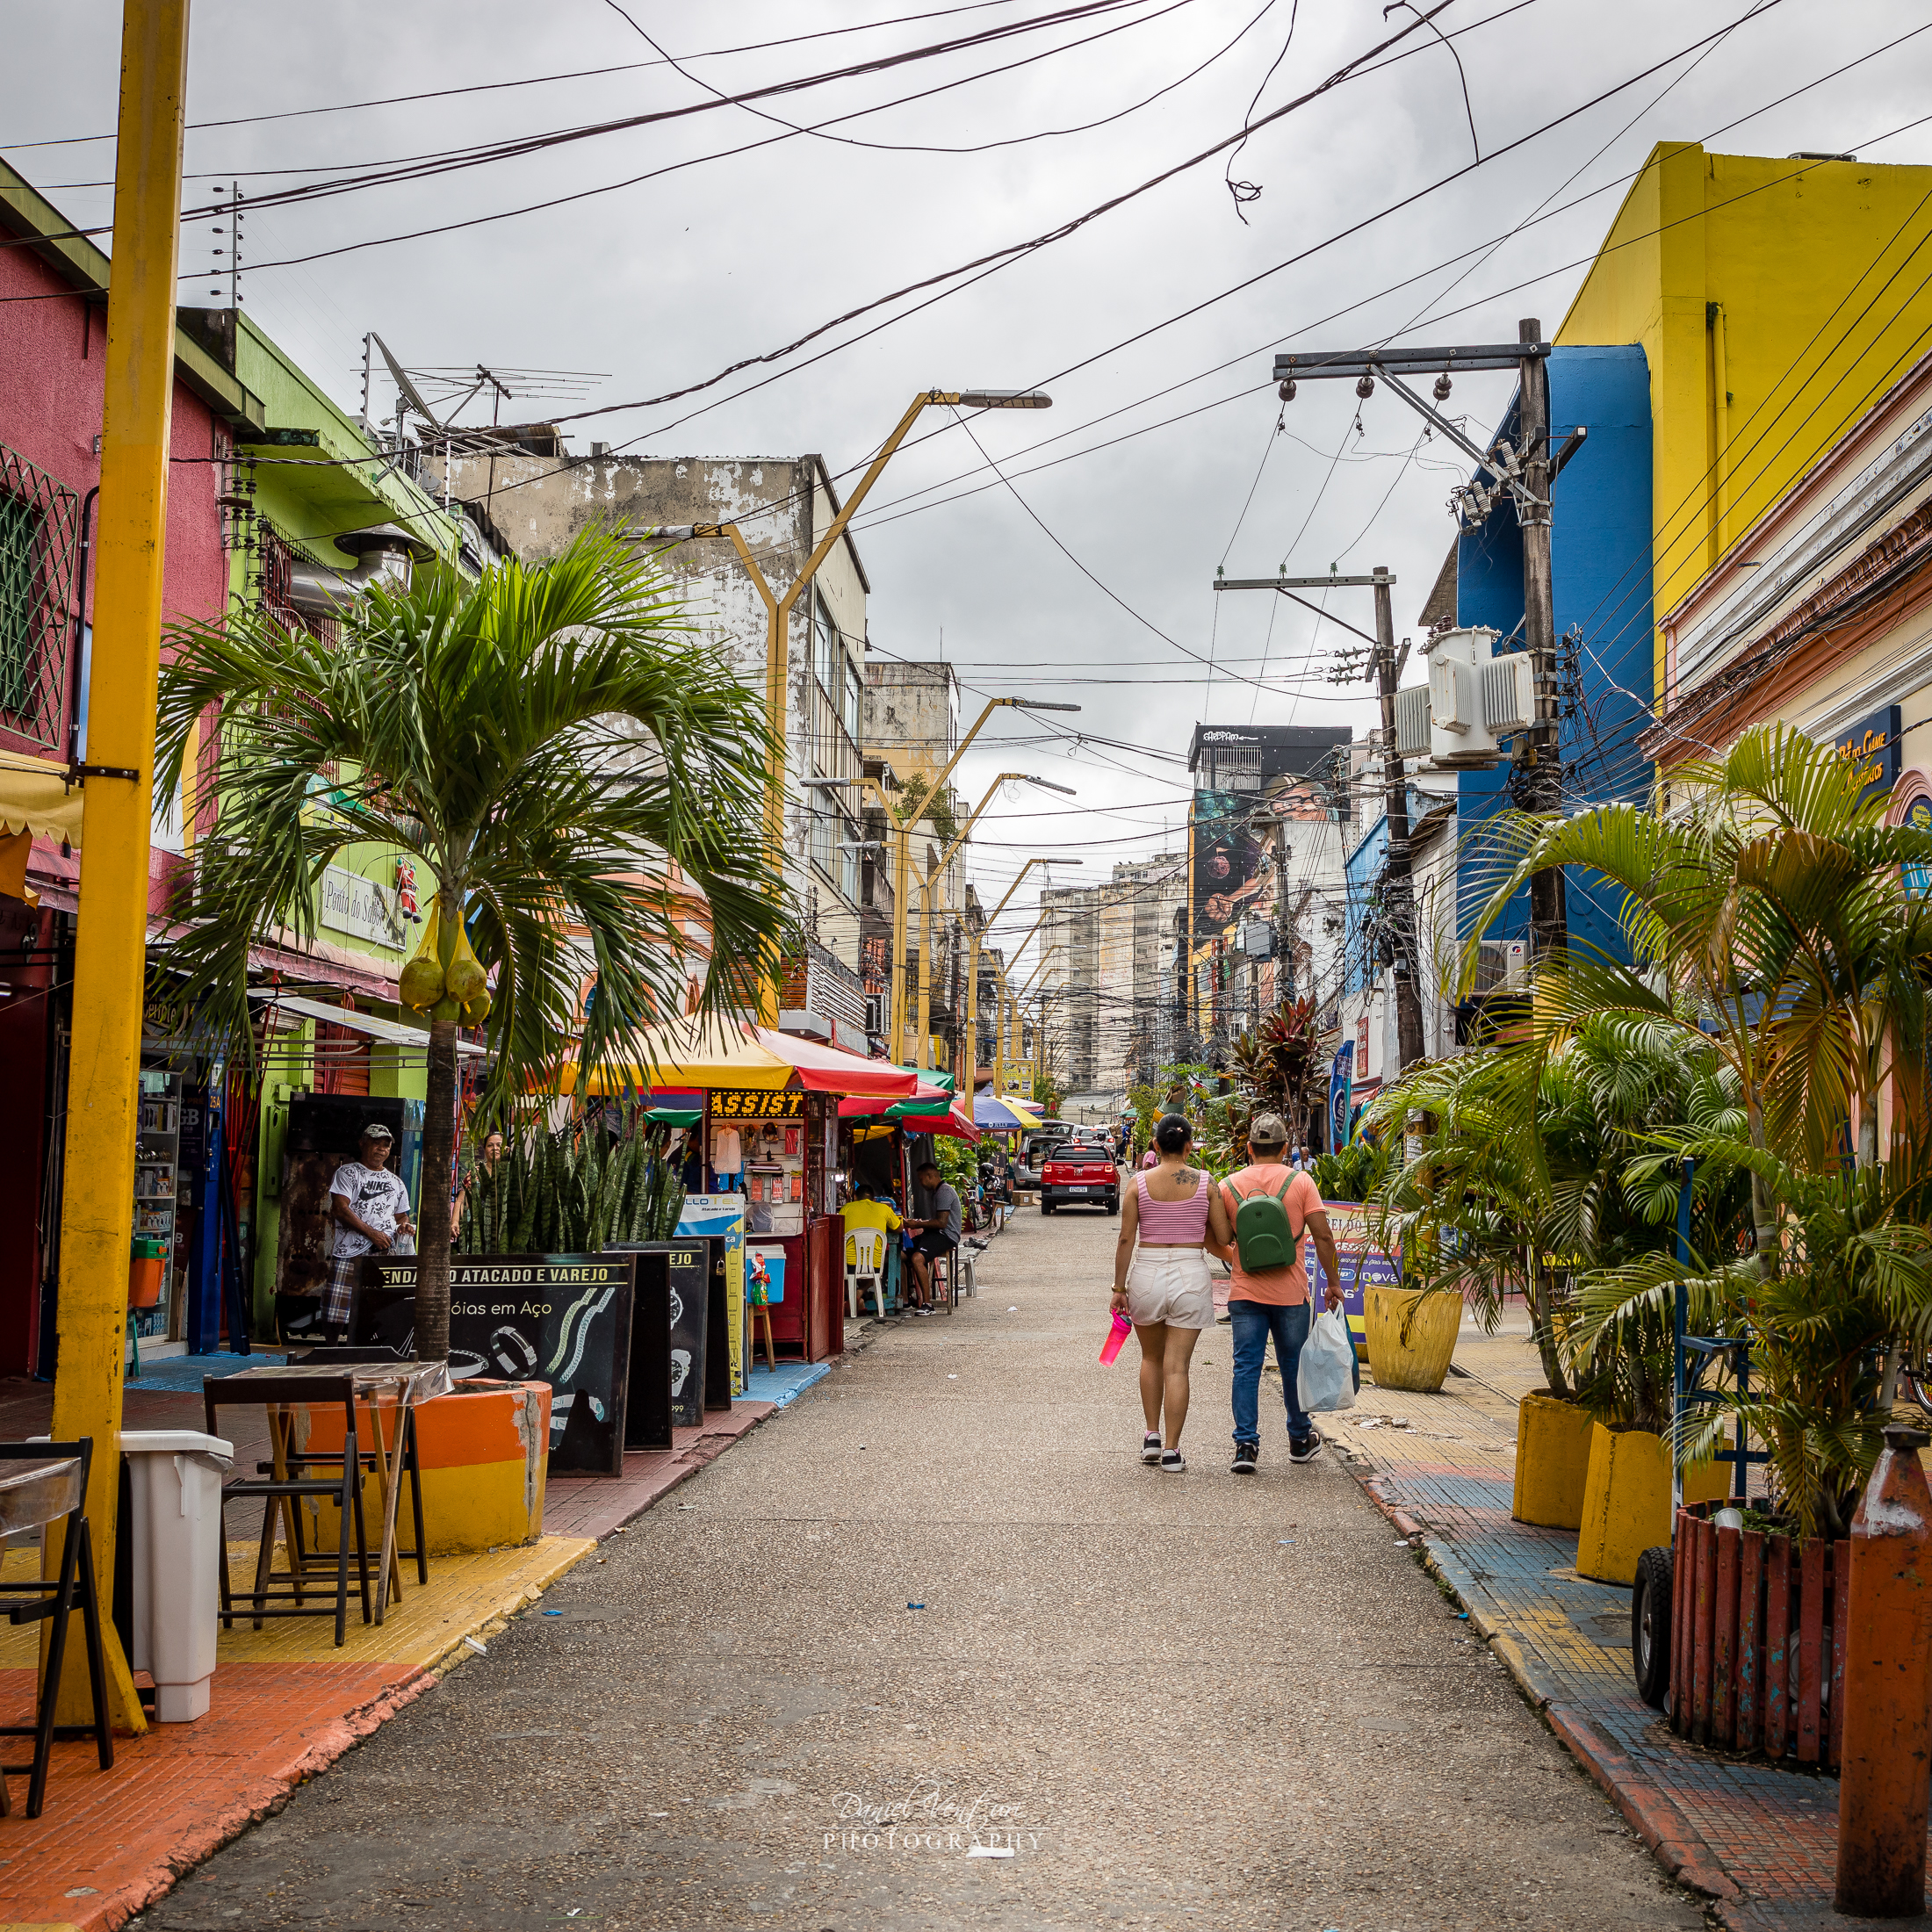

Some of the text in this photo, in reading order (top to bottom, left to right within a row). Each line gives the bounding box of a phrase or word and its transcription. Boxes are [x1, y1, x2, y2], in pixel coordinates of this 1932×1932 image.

[326, 880, 349, 915] Ponto
[351, 890, 361, 919] do
[366, 1179, 390, 1192] NIKE
[685, 1195, 739, 1206] LLOTEL
[461, 1268, 531, 1283] ATACADO
[537, 1268, 545, 1282] E
[550, 1268, 609, 1282] VAREJO
[451, 1301, 552, 1318] óias em Aço
